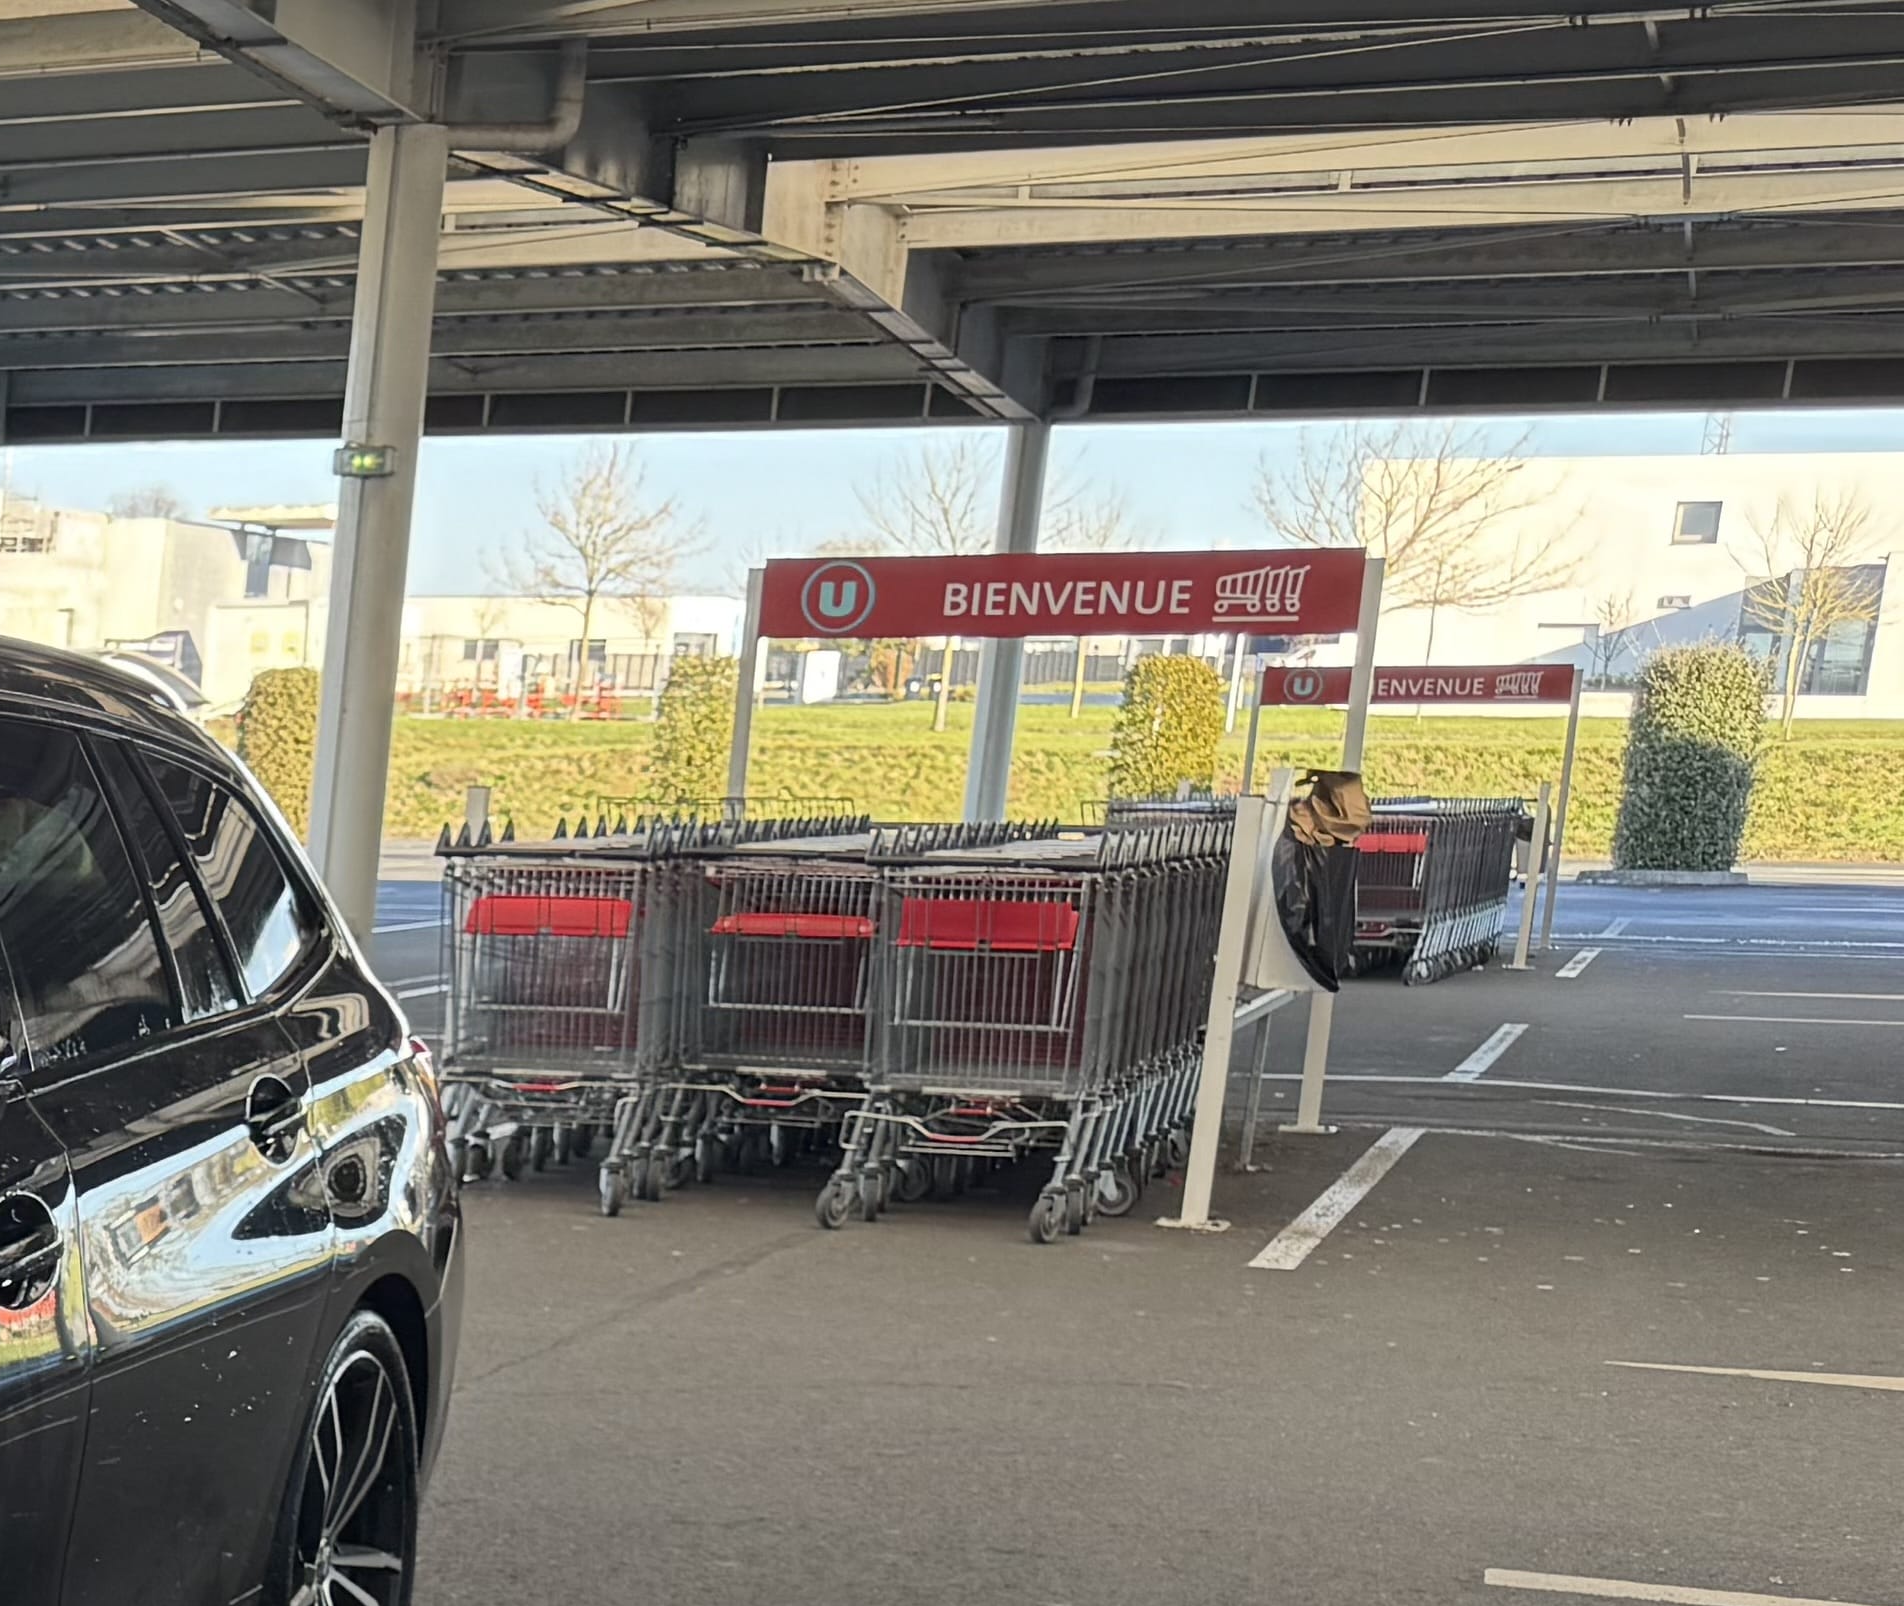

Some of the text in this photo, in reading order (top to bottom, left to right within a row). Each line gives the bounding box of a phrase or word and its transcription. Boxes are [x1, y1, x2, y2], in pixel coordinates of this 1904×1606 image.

[818, 580, 1193, 617] U BIENVENUE
[1293, 675, 1313, 696] U
